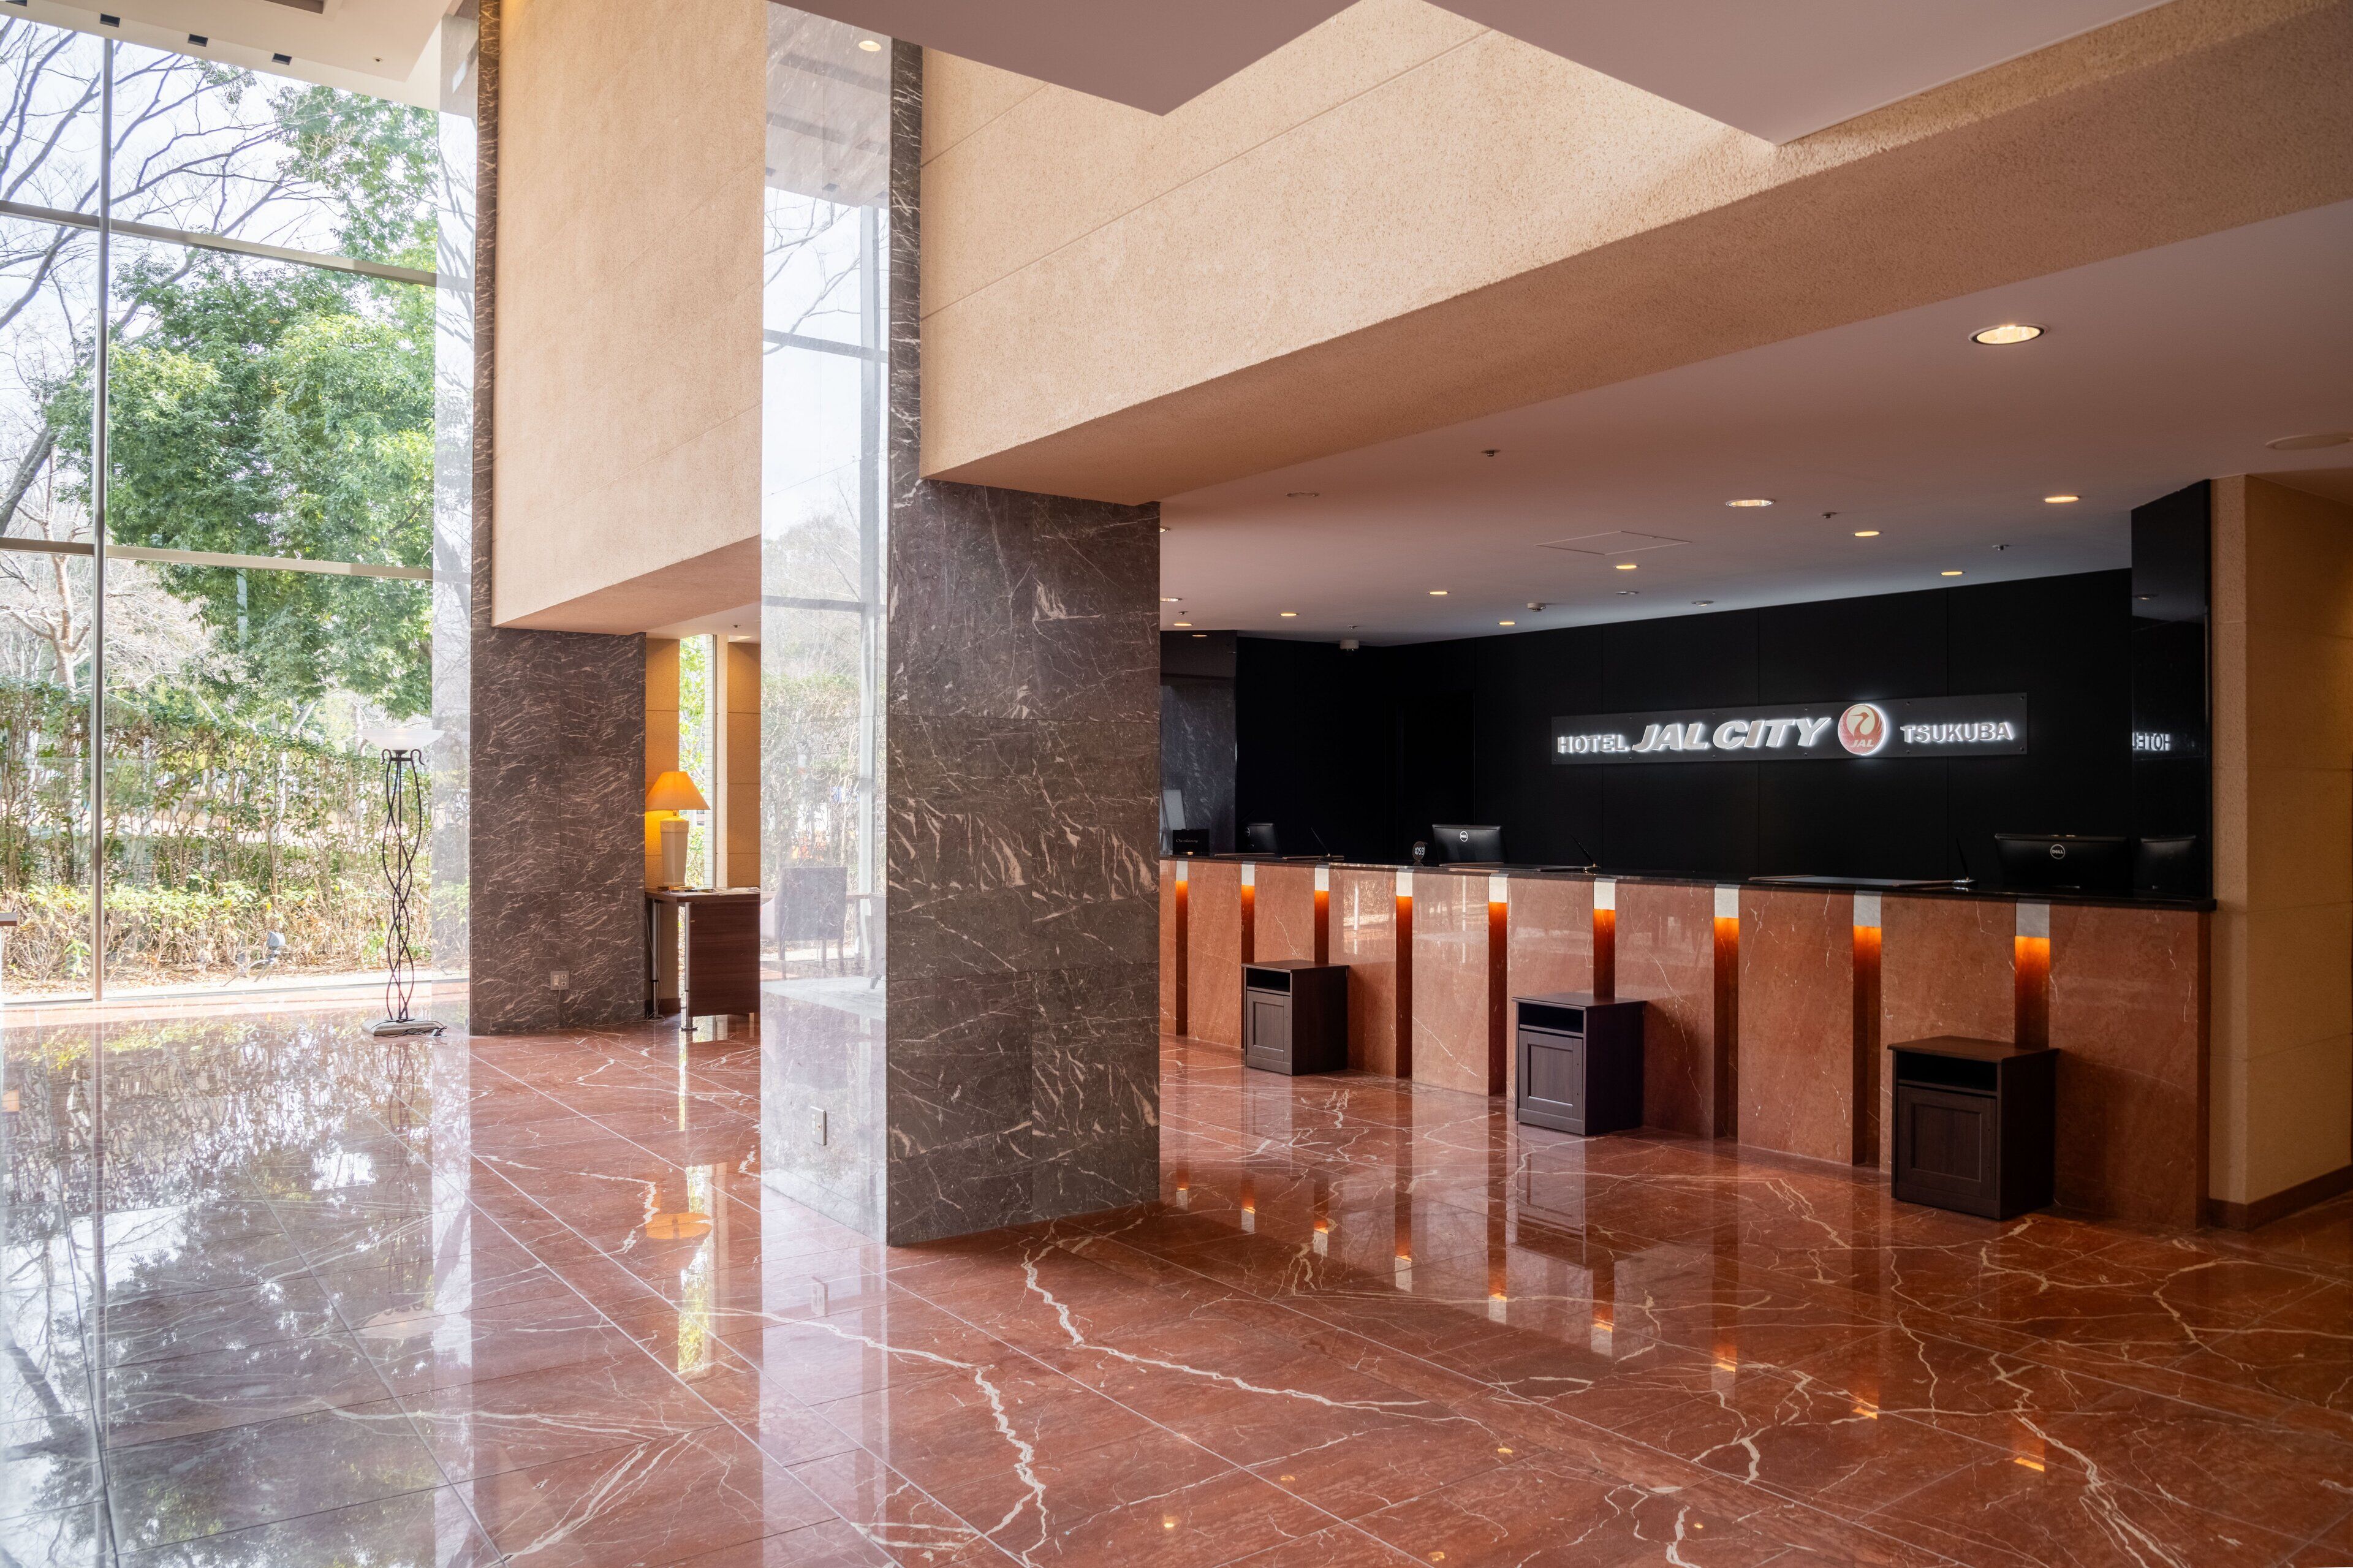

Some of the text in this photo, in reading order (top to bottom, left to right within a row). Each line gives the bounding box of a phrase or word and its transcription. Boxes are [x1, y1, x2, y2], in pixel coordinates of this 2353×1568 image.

[1557, 735, 1631, 753] HOTEL
[1900, 722, 2014, 743] TSUKUBA
[1851, 739, 1874, 748] JAL
